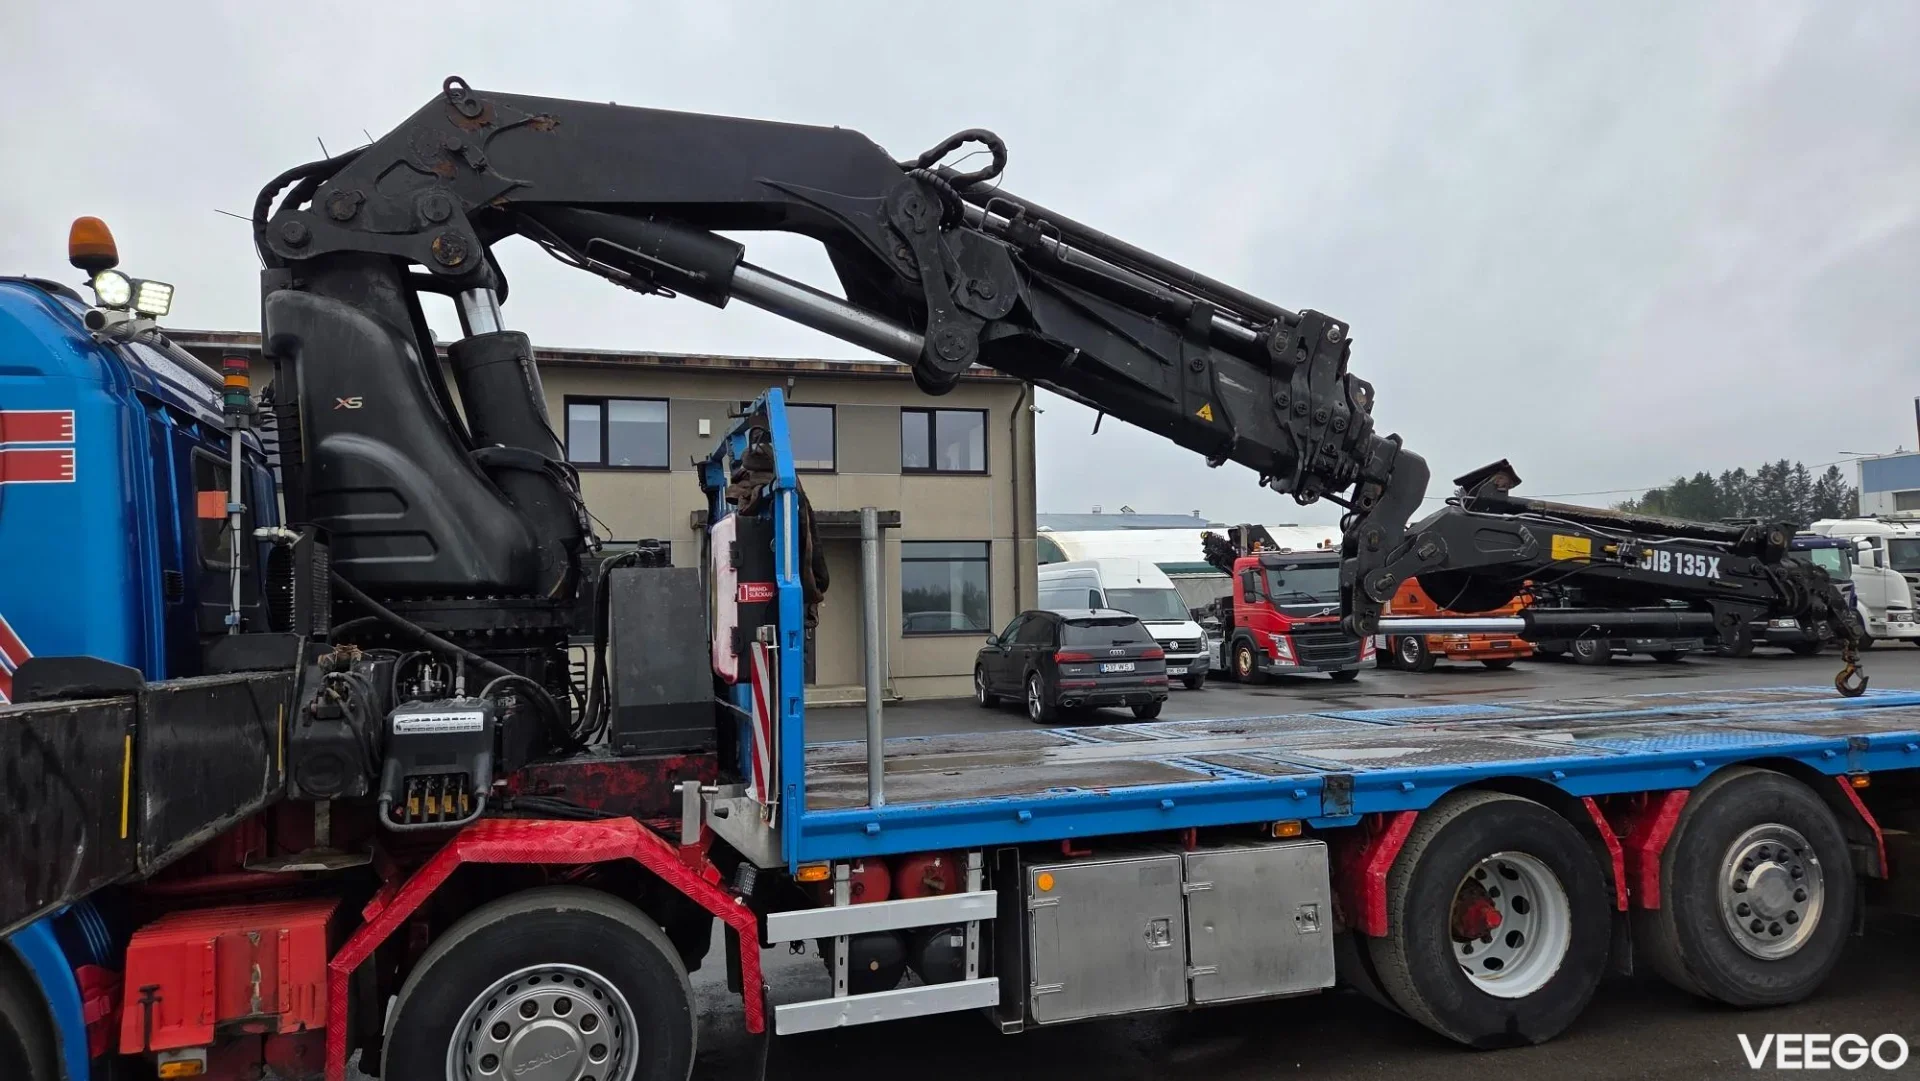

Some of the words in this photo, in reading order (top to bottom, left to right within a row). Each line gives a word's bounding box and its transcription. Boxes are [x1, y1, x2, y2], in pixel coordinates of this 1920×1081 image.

[333, 396, 363, 410] XS
[1641, 549, 1671, 573] JIB
[1674, 552, 1720, 579] 135X
[513, 1046, 576, 1076] SCANIA
